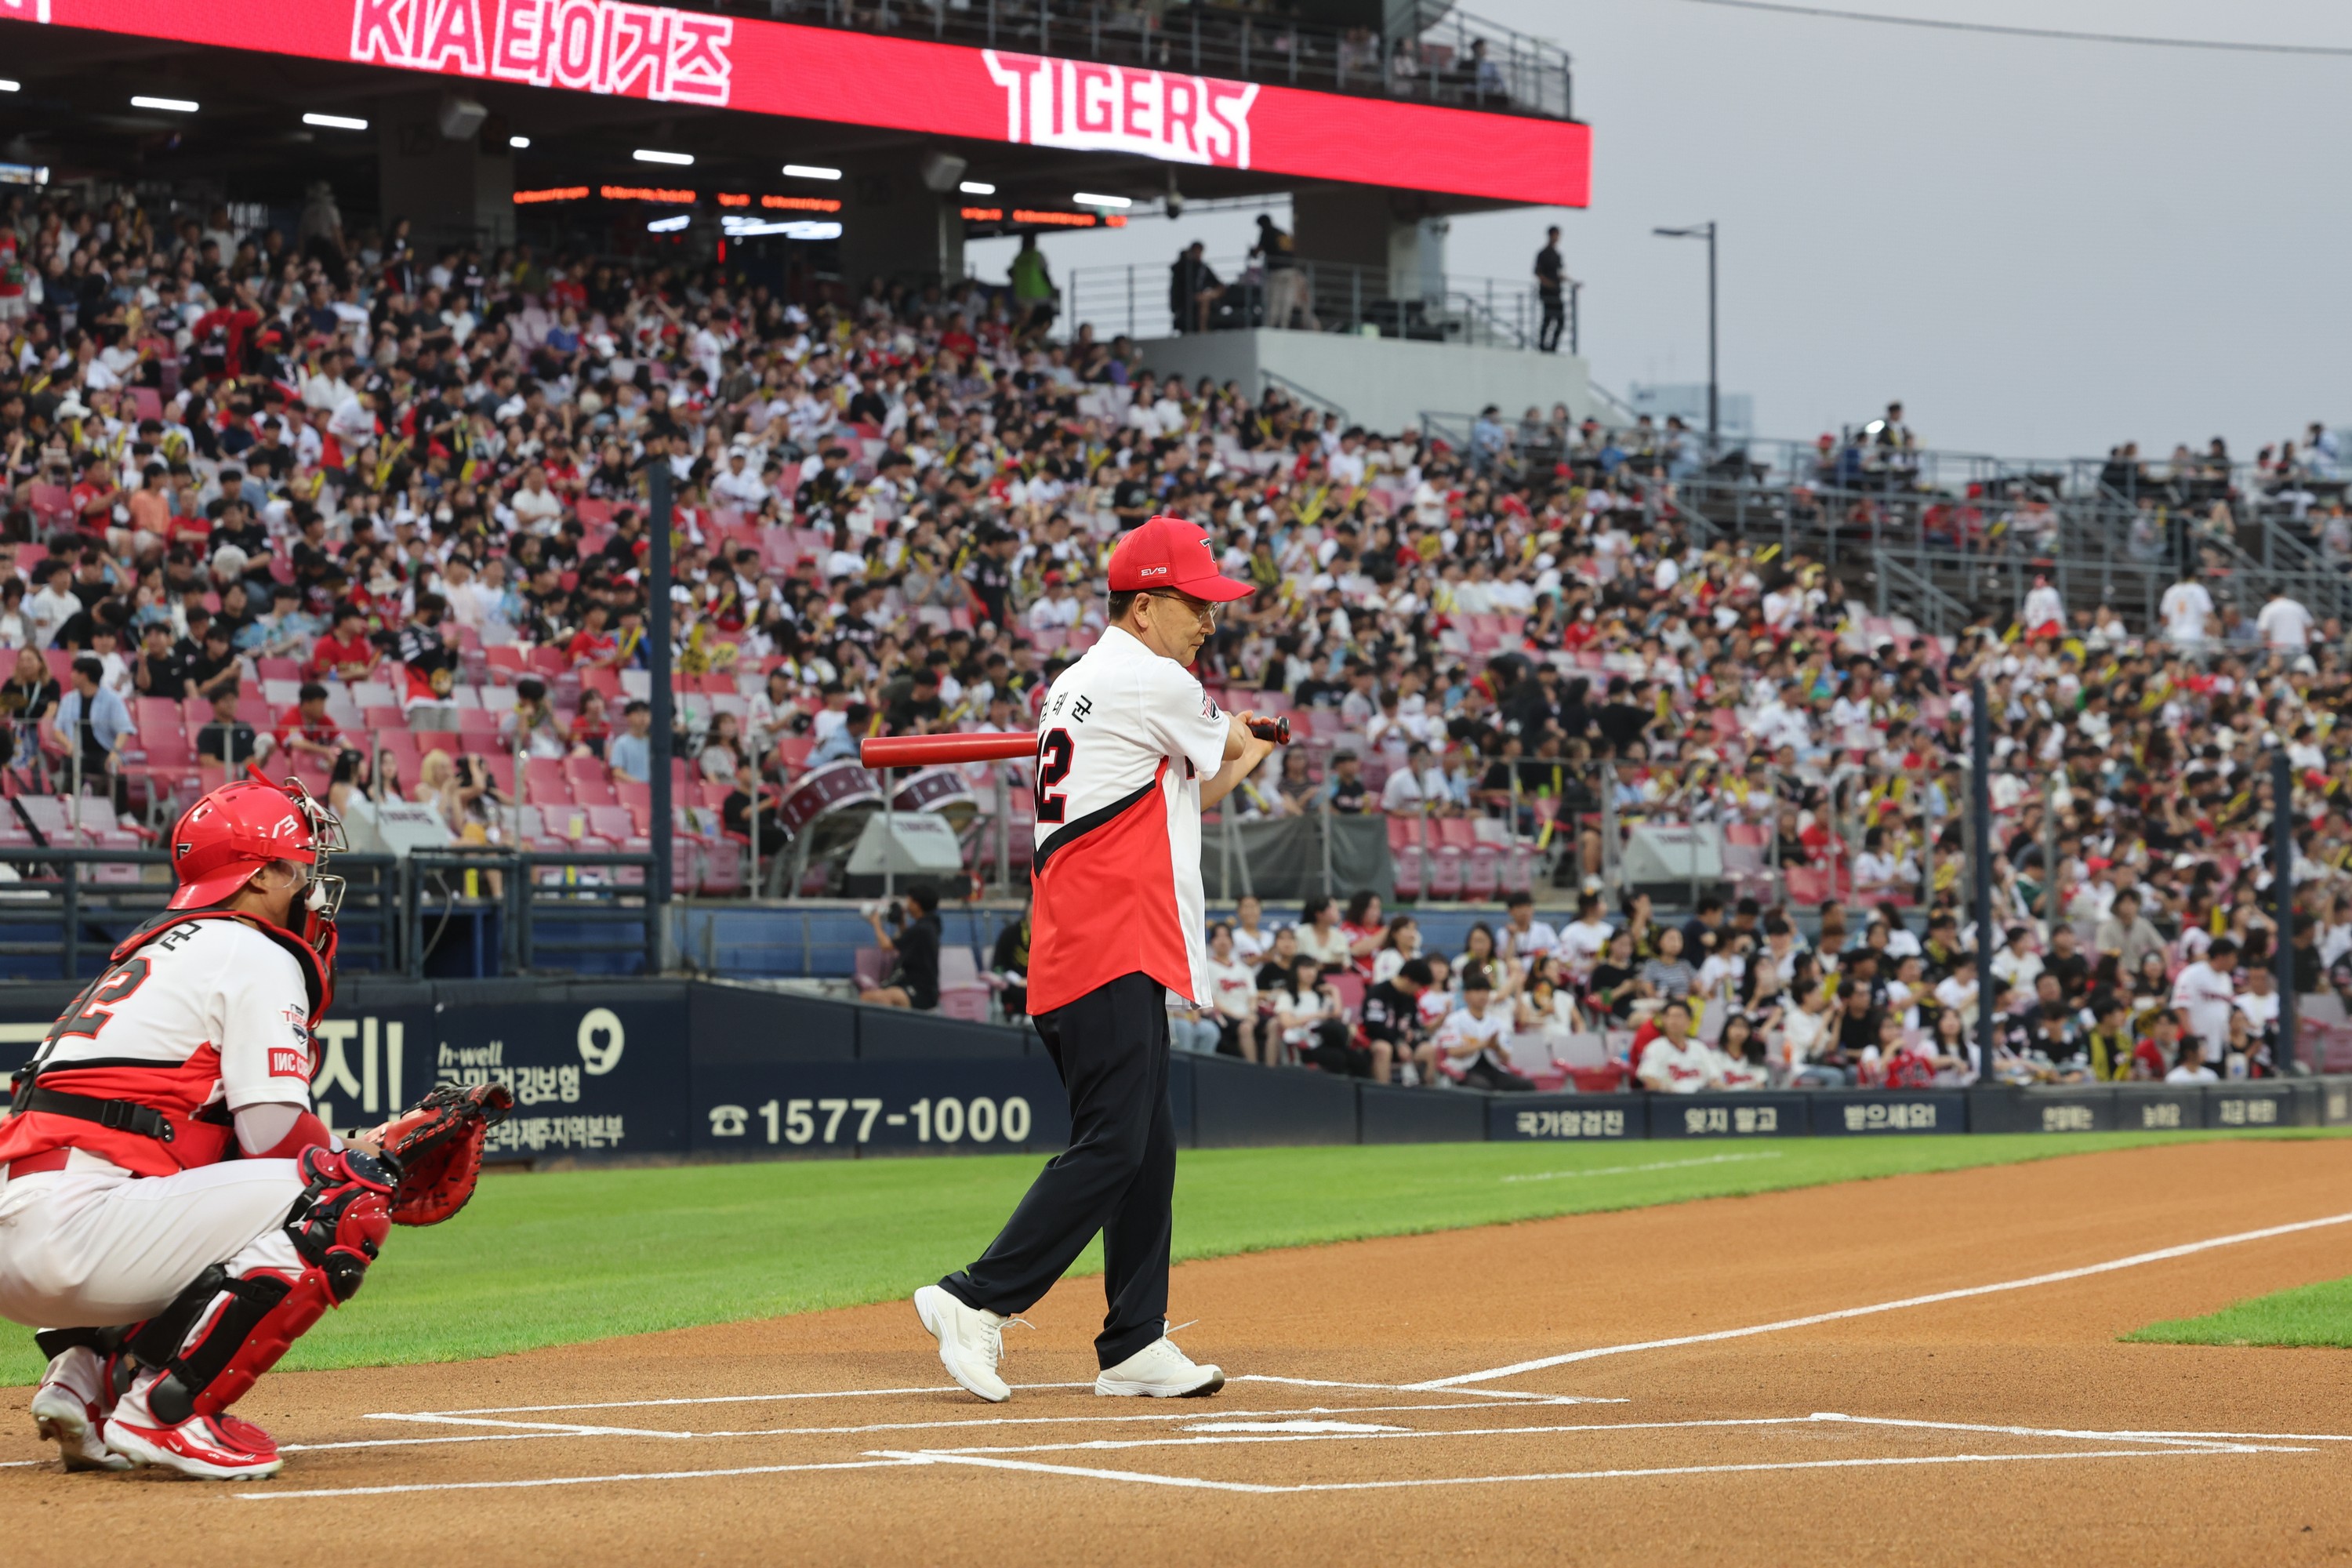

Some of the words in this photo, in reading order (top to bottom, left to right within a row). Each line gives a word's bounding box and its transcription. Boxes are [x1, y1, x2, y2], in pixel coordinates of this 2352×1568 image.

[350, 0, 486, 76] KIA
[491, 0, 734, 107] 타이거즈
[982, 49, 1261, 170] TIGERS
[1141, 566, 1167, 577] EV9
[758, 1096, 1032, 1144] 1577-1000
